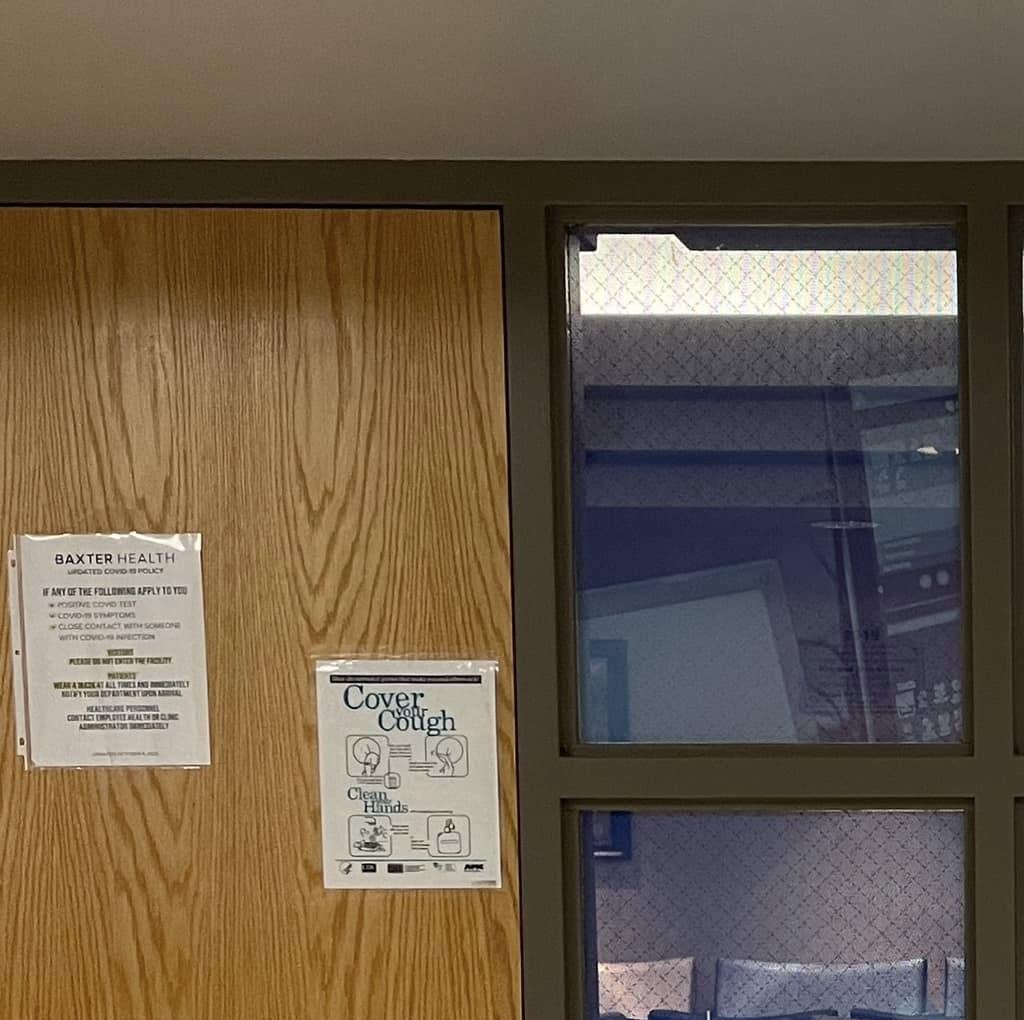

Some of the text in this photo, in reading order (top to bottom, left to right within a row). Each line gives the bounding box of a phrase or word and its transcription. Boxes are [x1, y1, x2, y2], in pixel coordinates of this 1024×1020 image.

[54, 552, 175, 565] BAXTER HEALTH
[42, 587, 50, 596] IF
[51, 587, 66, 596] ANY
[67, 587, 77, 596] OF
[79, 587, 92, 596] THE
[94, 587, 136, 596] FOLLOWING
[138, 586, 161, 596] APPLY
[162, 586, 172, 595] TO
[119, 600, 137, 608] TEST
[343, 684, 424, 709] Cover
[378, 709, 456, 736] Cough
[347, 787, 387, 801] Clean
[364, 800, 408, 813] Hands
